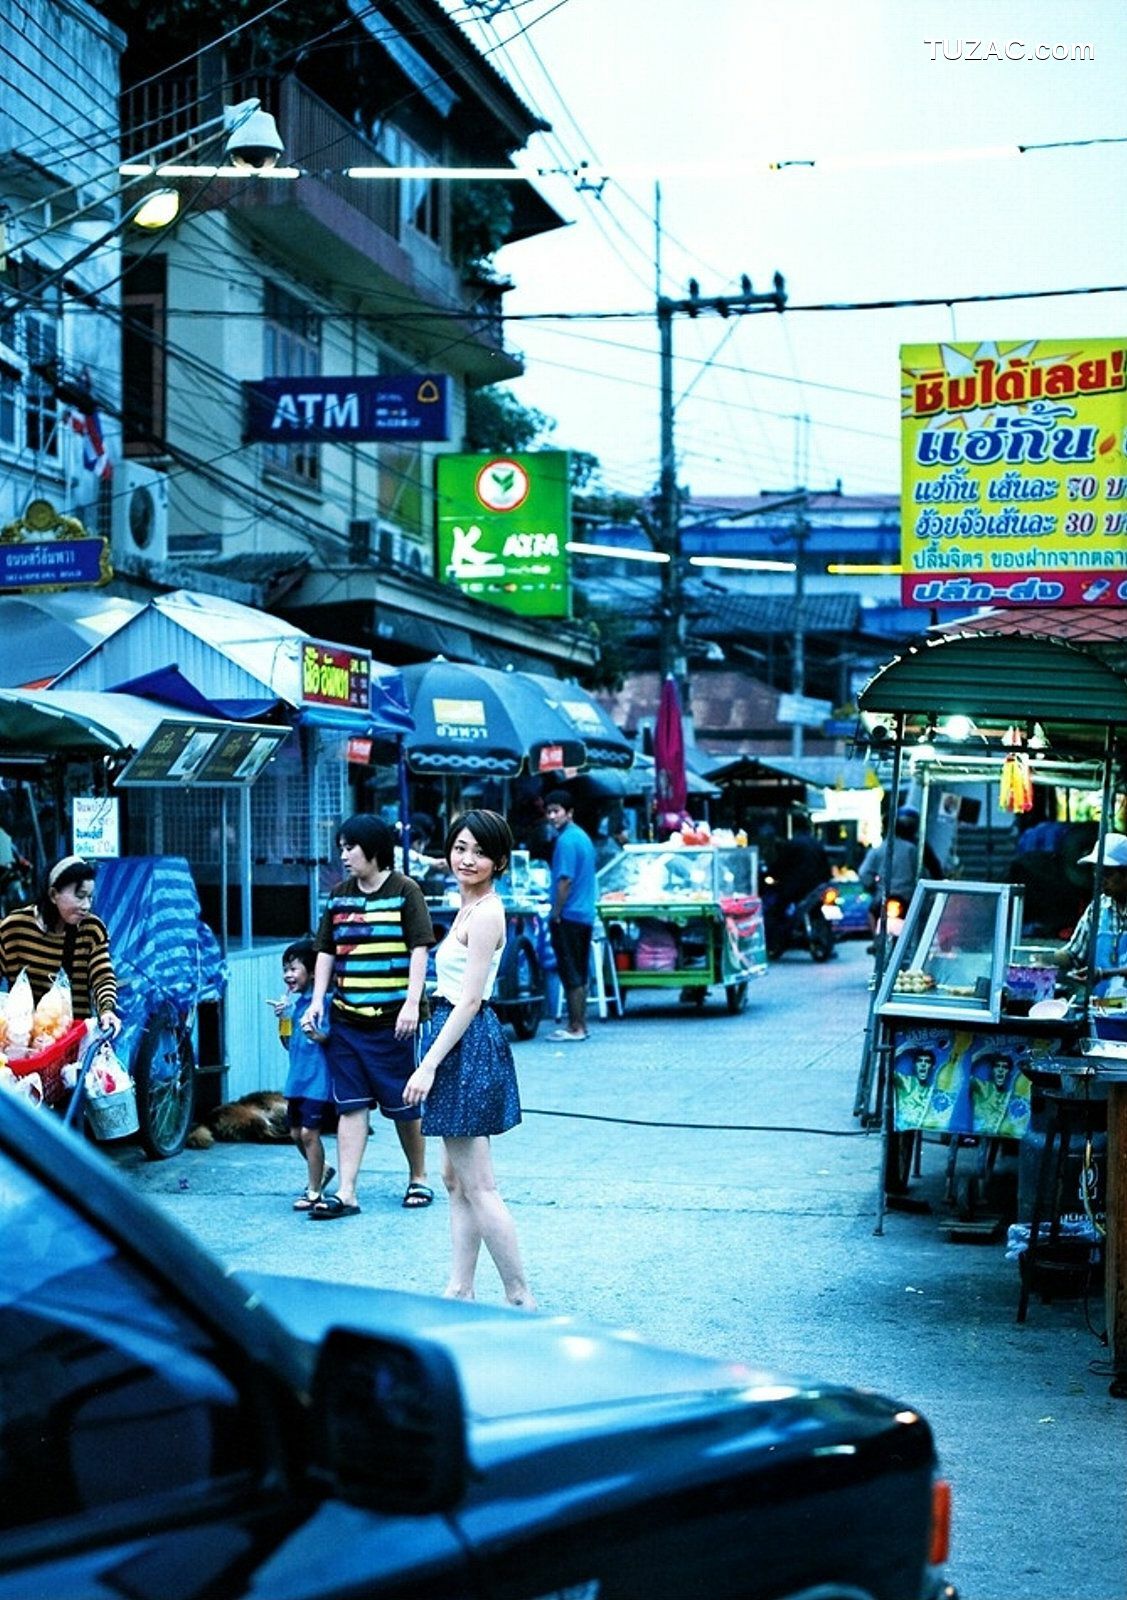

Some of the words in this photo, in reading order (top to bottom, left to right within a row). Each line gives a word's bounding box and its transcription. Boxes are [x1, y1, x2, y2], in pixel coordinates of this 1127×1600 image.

[914, 350, 1125, 414] ชิมได้เลย!
[271, 393, 360, 429] ATM
[988, 472, 1058, 499] เส้นละ
[1067, 477, 1097, 498] 70
[1064, 512, 1095, 535] 30
[502, 533, 560, 557] ATM
[991, 547, 1127, 568] ของฝากจากตลา
[914, 577, 1063, 602] ปลีก-ส่ง
